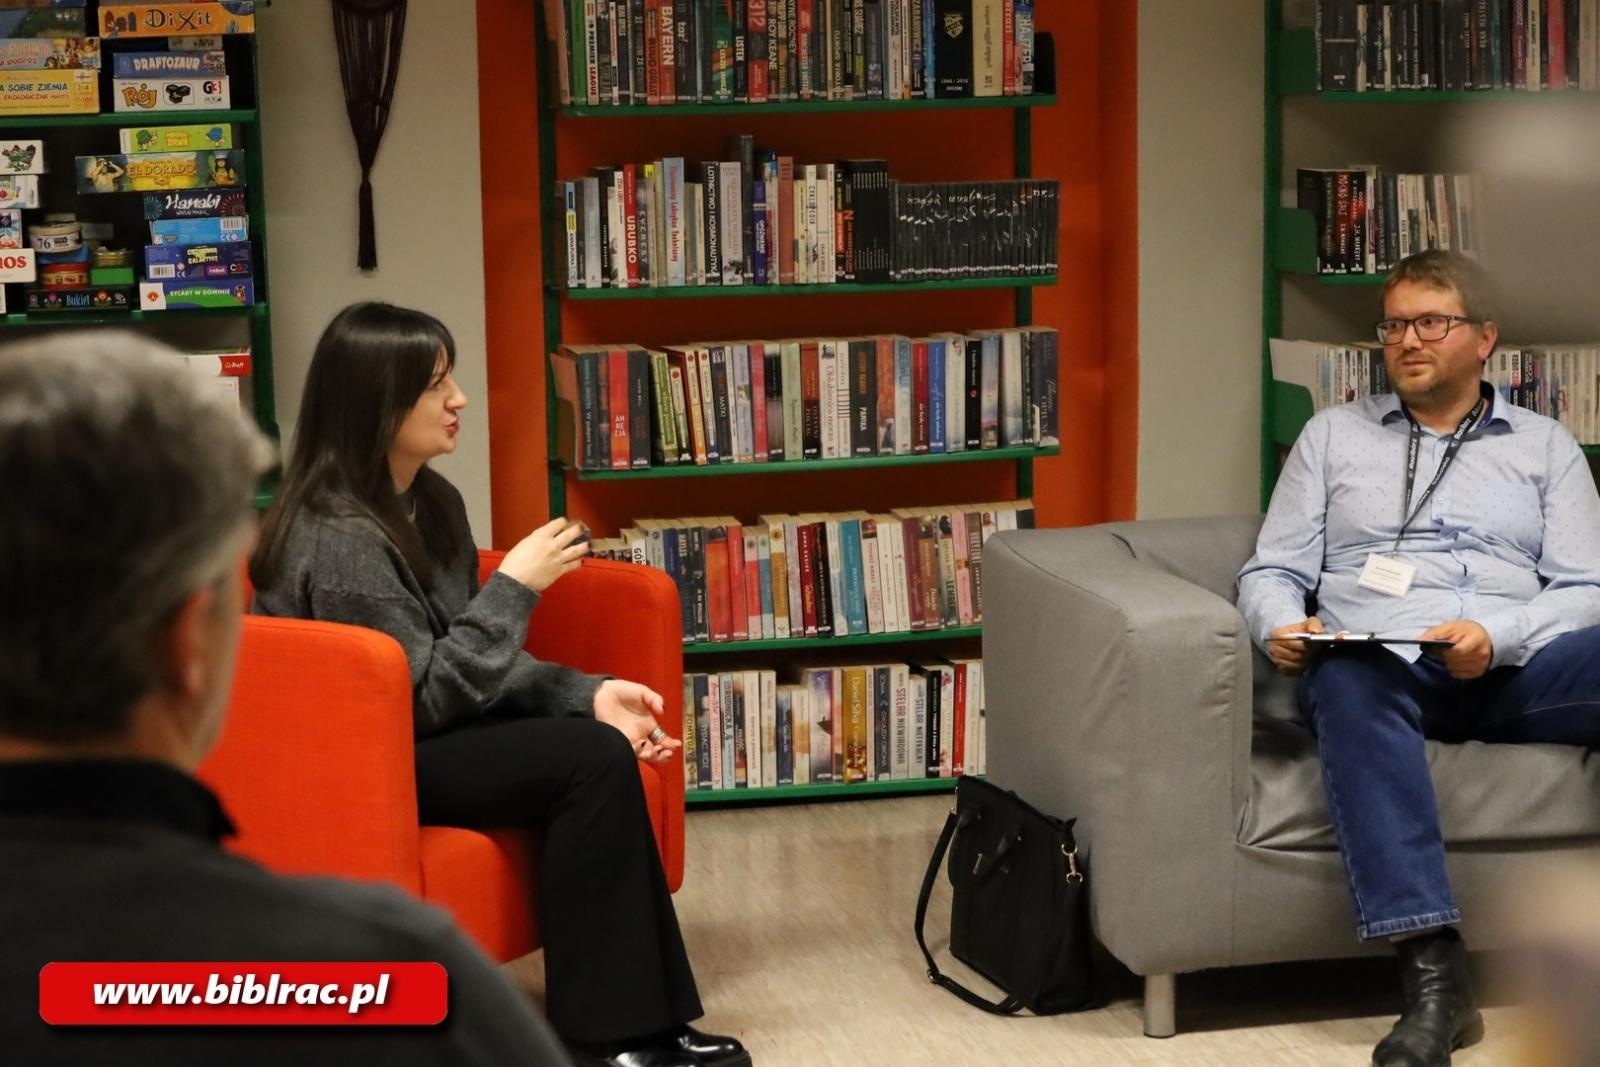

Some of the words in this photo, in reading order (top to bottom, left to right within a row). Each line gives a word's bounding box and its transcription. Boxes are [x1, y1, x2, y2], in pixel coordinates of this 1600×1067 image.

[145, 9, 212, 30] DiXit
[768, 19, 777, 38] ROY
[661, 6, 674, 65] BAYERN
[134, 56, 200, 71] DRAFTOZAUR
[769, 40, 777, 71] KEANE
[8, 83, 33, 91] SOBIE
[37, 83, 67, 91] ZIEMIA
[122, 82, 158, 108] Rój
[144, 163, 195, 175] DORADO
[707, 166, 716, 210] LOTNICTWO
[165, 193, 222, 210] Hanabi
[37, 238, 51, 249] 76
[627, 215, 637, 264] URUBKO
[639, 210, 648, 264] EVEREST
[708, 215, 718, 275] KOSMONAUTYKA
[66, 294, 90, 306] Bukiet
[719, 396, 727, 418] MATKI
[860, 407, 868, 431] PANIKA
[1041, 396, 1050, 433] OPIUM
[1454, 418, 1471, 440] Racibórz
[851, 677, 861, 702] Daniel
[724, 690, 733, 730] RUDNICKA
[852, 703, 862, 724] Silva
[896, 688, 906, 716] STELAR
[915, 698, 924, 723] STELAR
